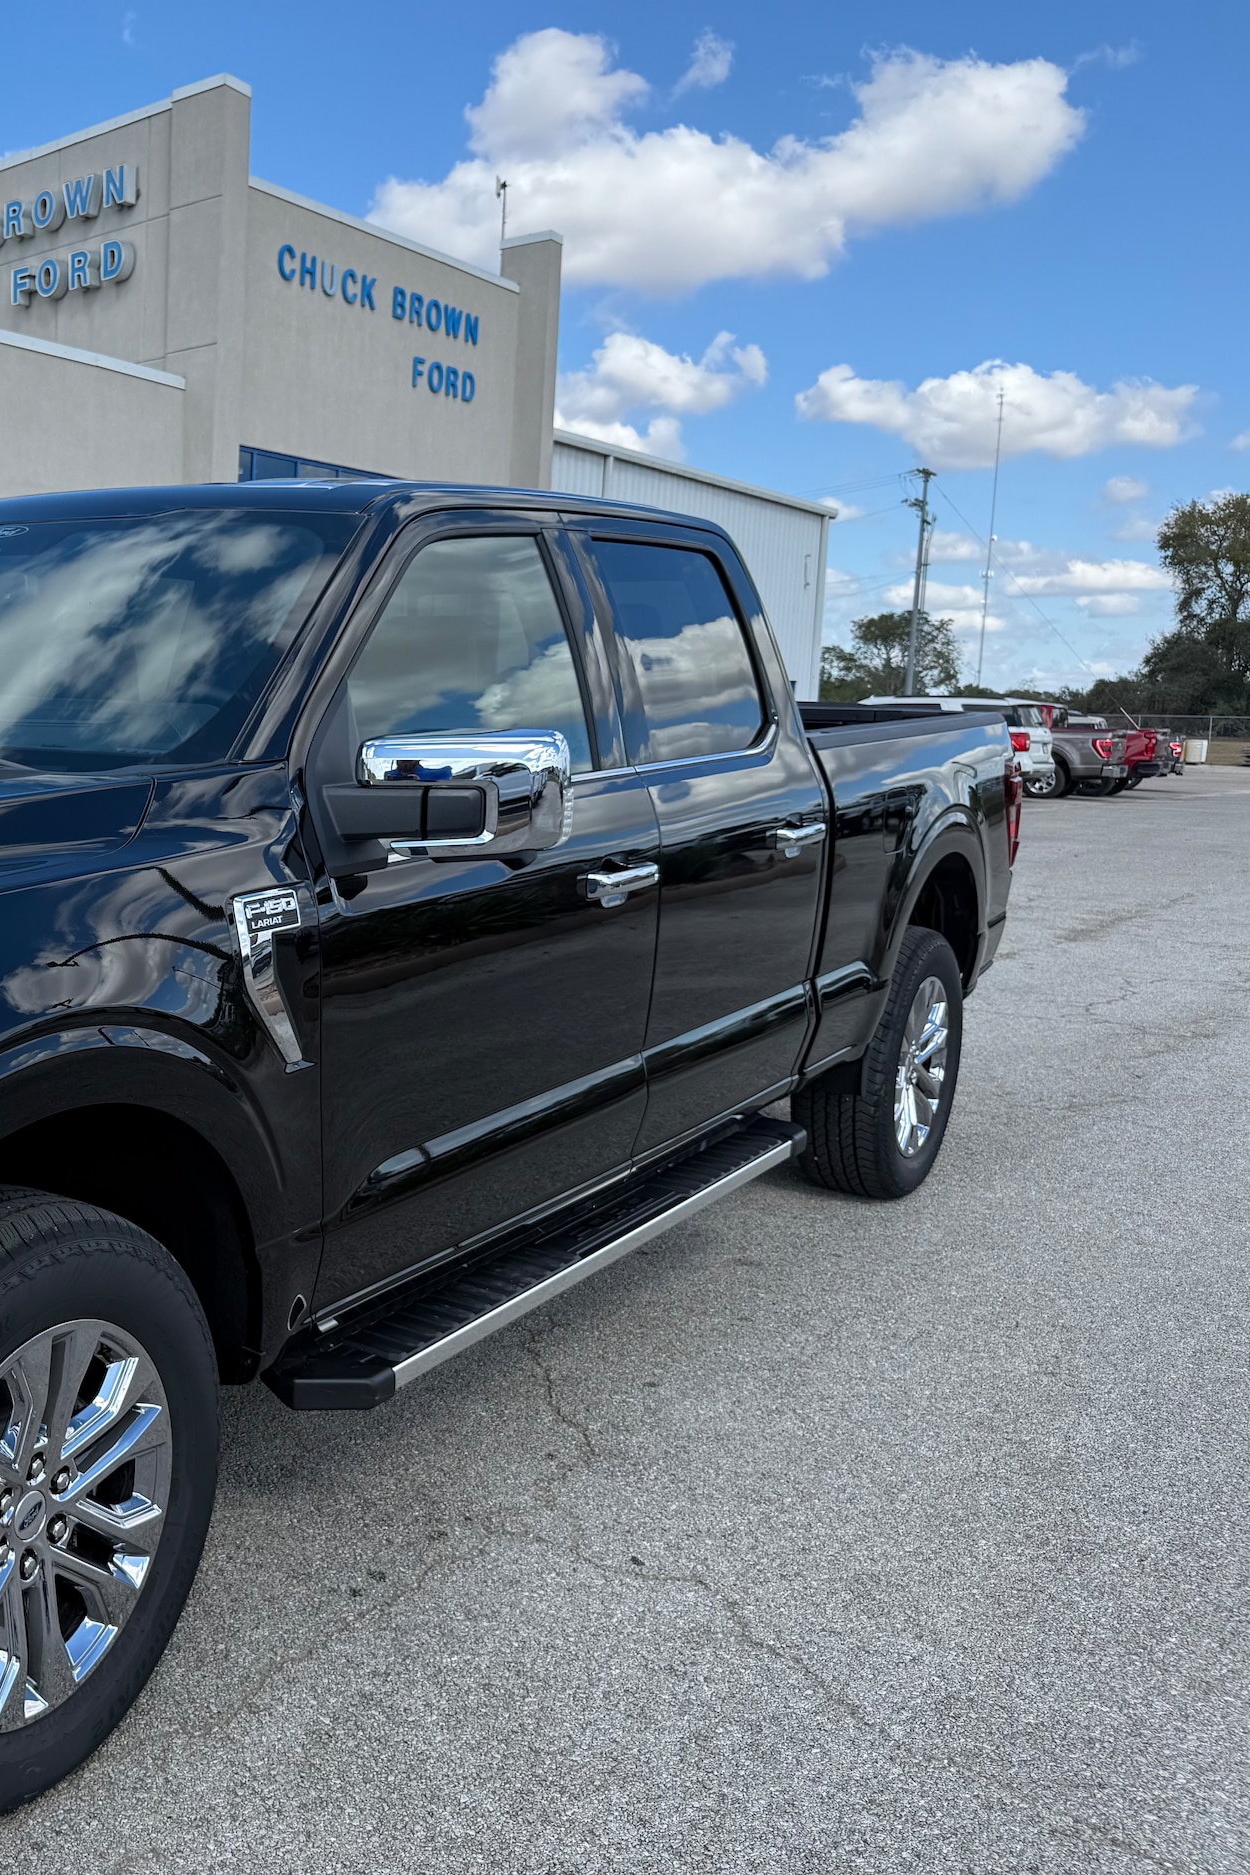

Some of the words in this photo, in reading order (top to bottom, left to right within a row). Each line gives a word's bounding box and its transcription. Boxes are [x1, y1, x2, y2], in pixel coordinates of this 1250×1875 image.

[11, 240, 132, 306] FORD
[278, 244, 377, 310] CHUCK
[392, 286, 479, 345] BROWN
[412, 356, 476, 402] FORD
[245, 897, 296, 919] F-150
[251, 915, 283, 930] LARIAT
